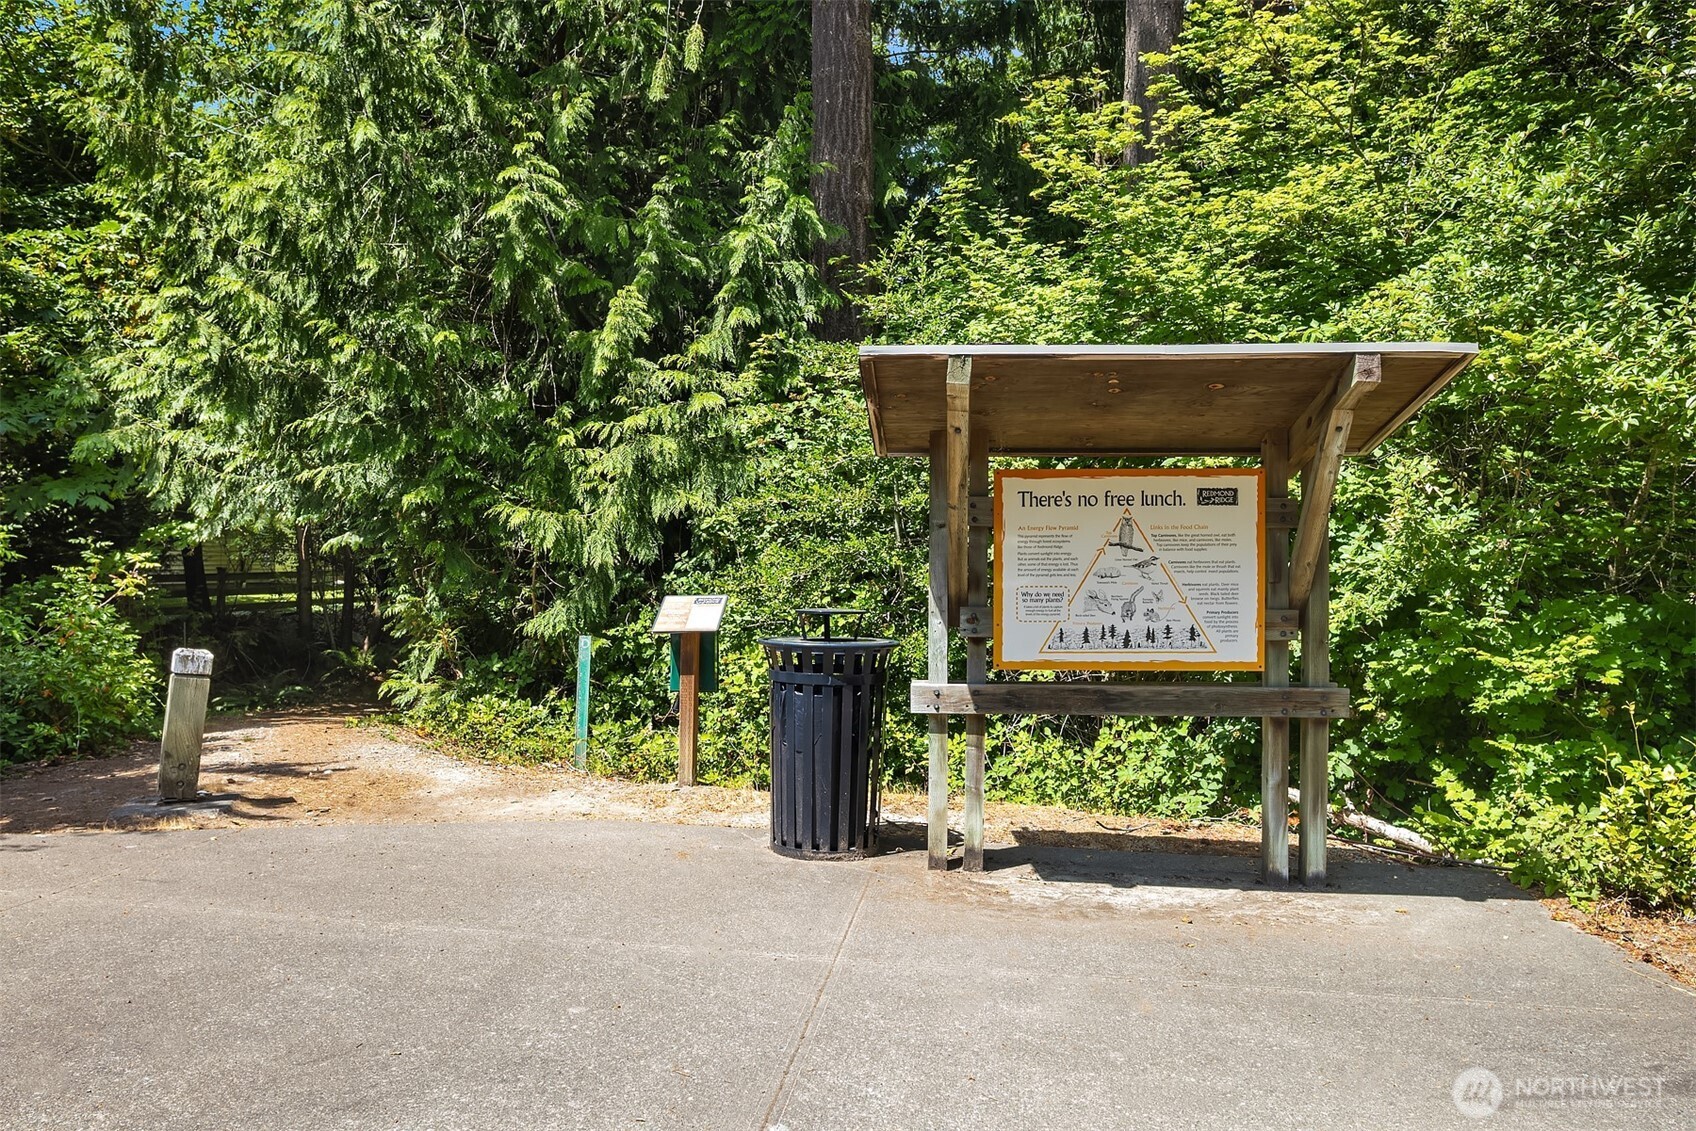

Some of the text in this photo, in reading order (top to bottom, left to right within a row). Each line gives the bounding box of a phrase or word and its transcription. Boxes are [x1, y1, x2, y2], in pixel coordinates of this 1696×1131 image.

[1017, 490, 1187, 508] There's no free lunch.
